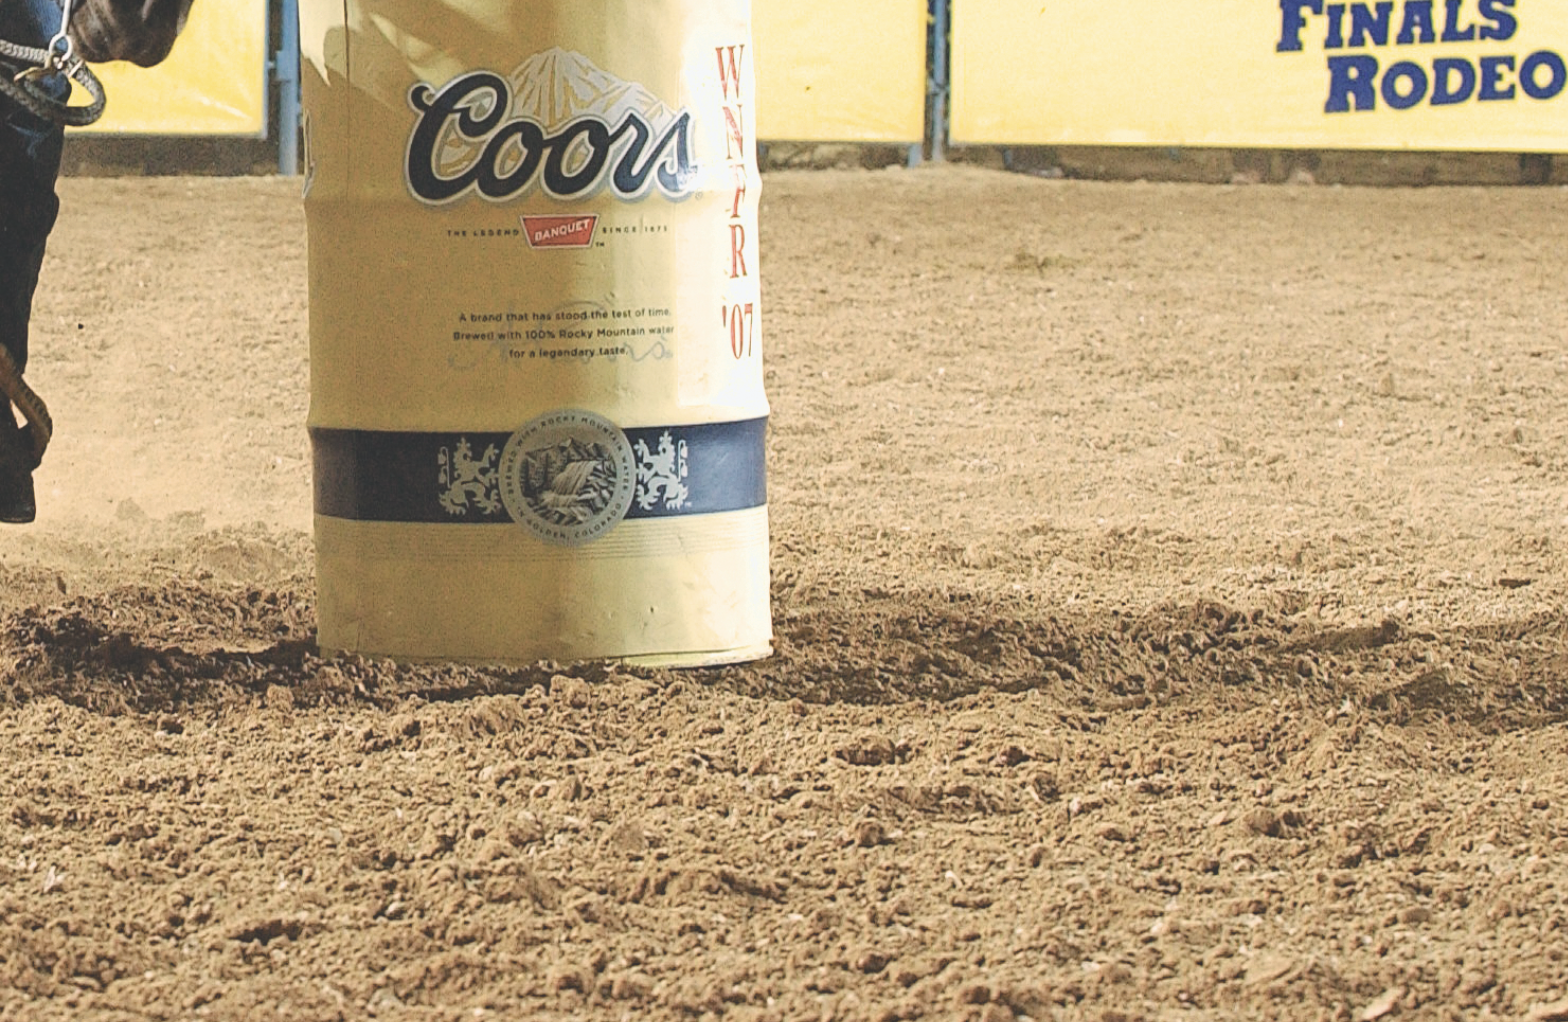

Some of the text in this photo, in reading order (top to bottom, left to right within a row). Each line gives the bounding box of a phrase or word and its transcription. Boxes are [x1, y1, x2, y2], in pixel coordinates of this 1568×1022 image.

[1324, 49, 1568, 113] RODEO
[408, 71, 698, 206] Coors
[534, 218, 591, 242] BANQUET
[459, 313, 466, 322] A
[471, 313, 502, 322] brand
[507, 312, 529, 321] that
[532, 312, 551, 321] has
[556, 310, 587, 320] stood
[591, 310, 608, 320] the
[612, 309, 631, 319] test
[635, 308, 645, 317] of
[453, 325, 674, 341] Brewed with 100% Rocky Mountain water
[509, 348, 525, 358] for
[539, 347, 595, 360] legendary
